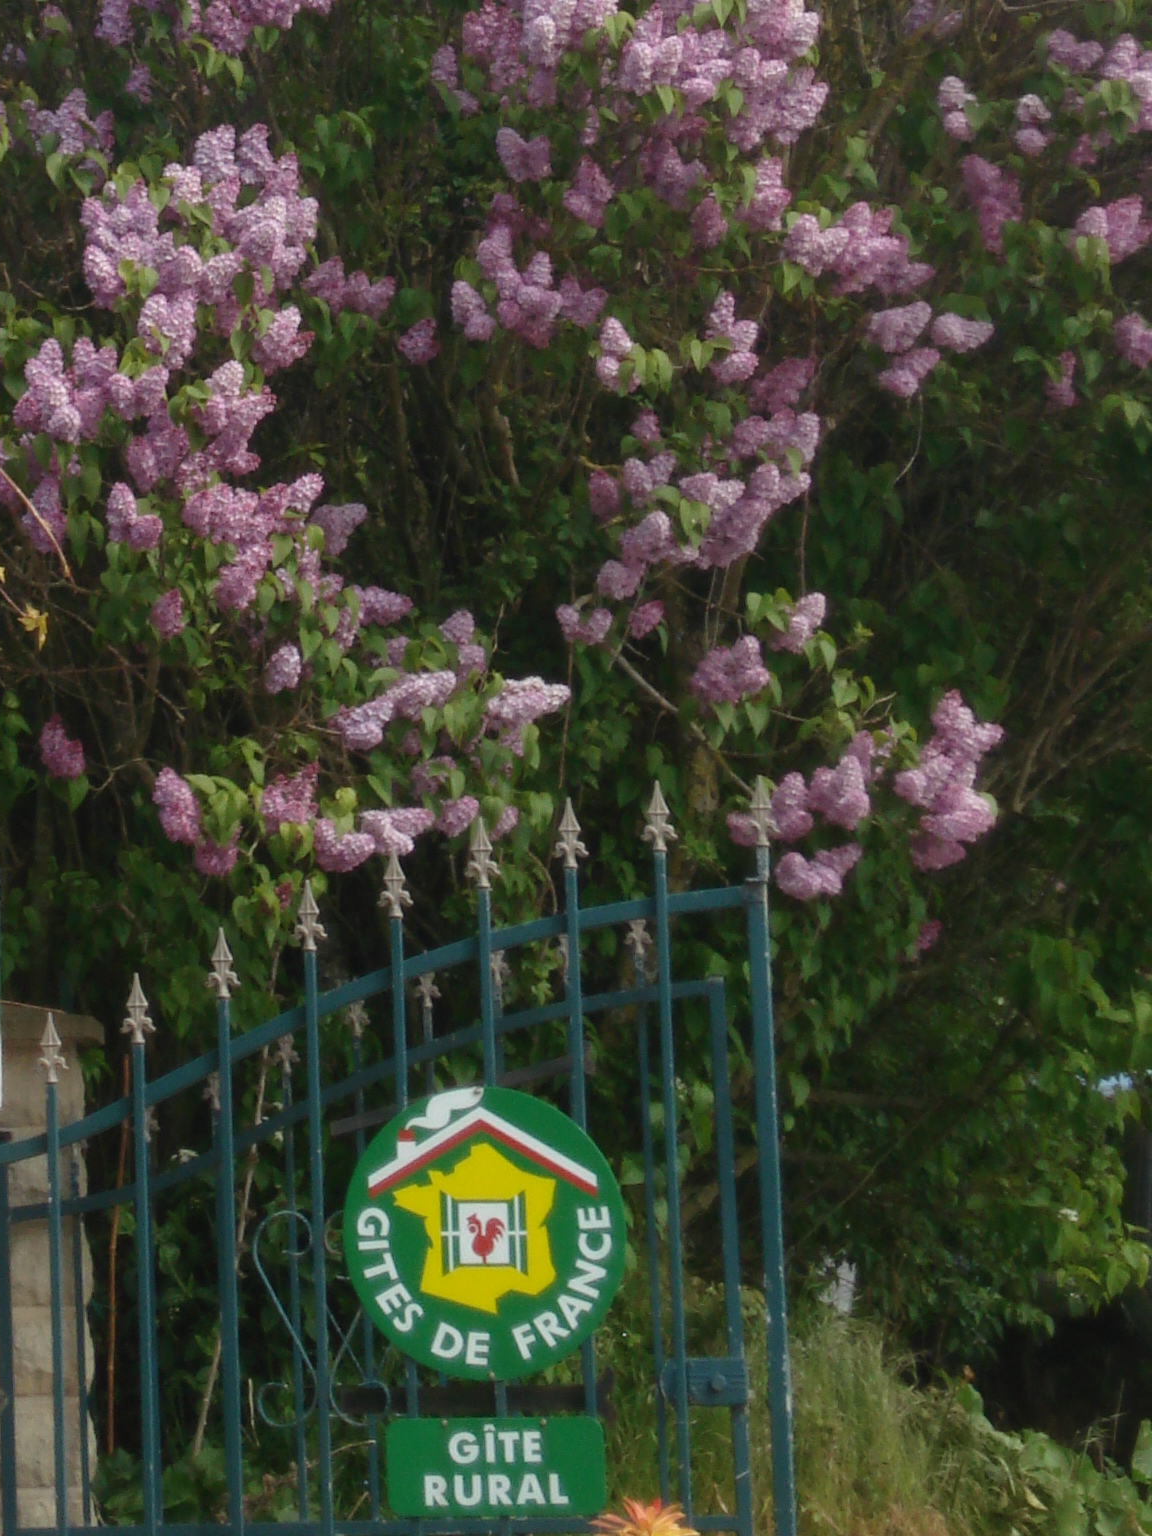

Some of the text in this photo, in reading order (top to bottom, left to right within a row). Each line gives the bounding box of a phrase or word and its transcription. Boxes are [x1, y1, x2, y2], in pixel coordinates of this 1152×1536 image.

[356, 1205, 612, 1366] GITES DE FRANCE
[448, 1423, 542, 1464] GÎTE
[423, 1473, 570, 1507] RURAL
